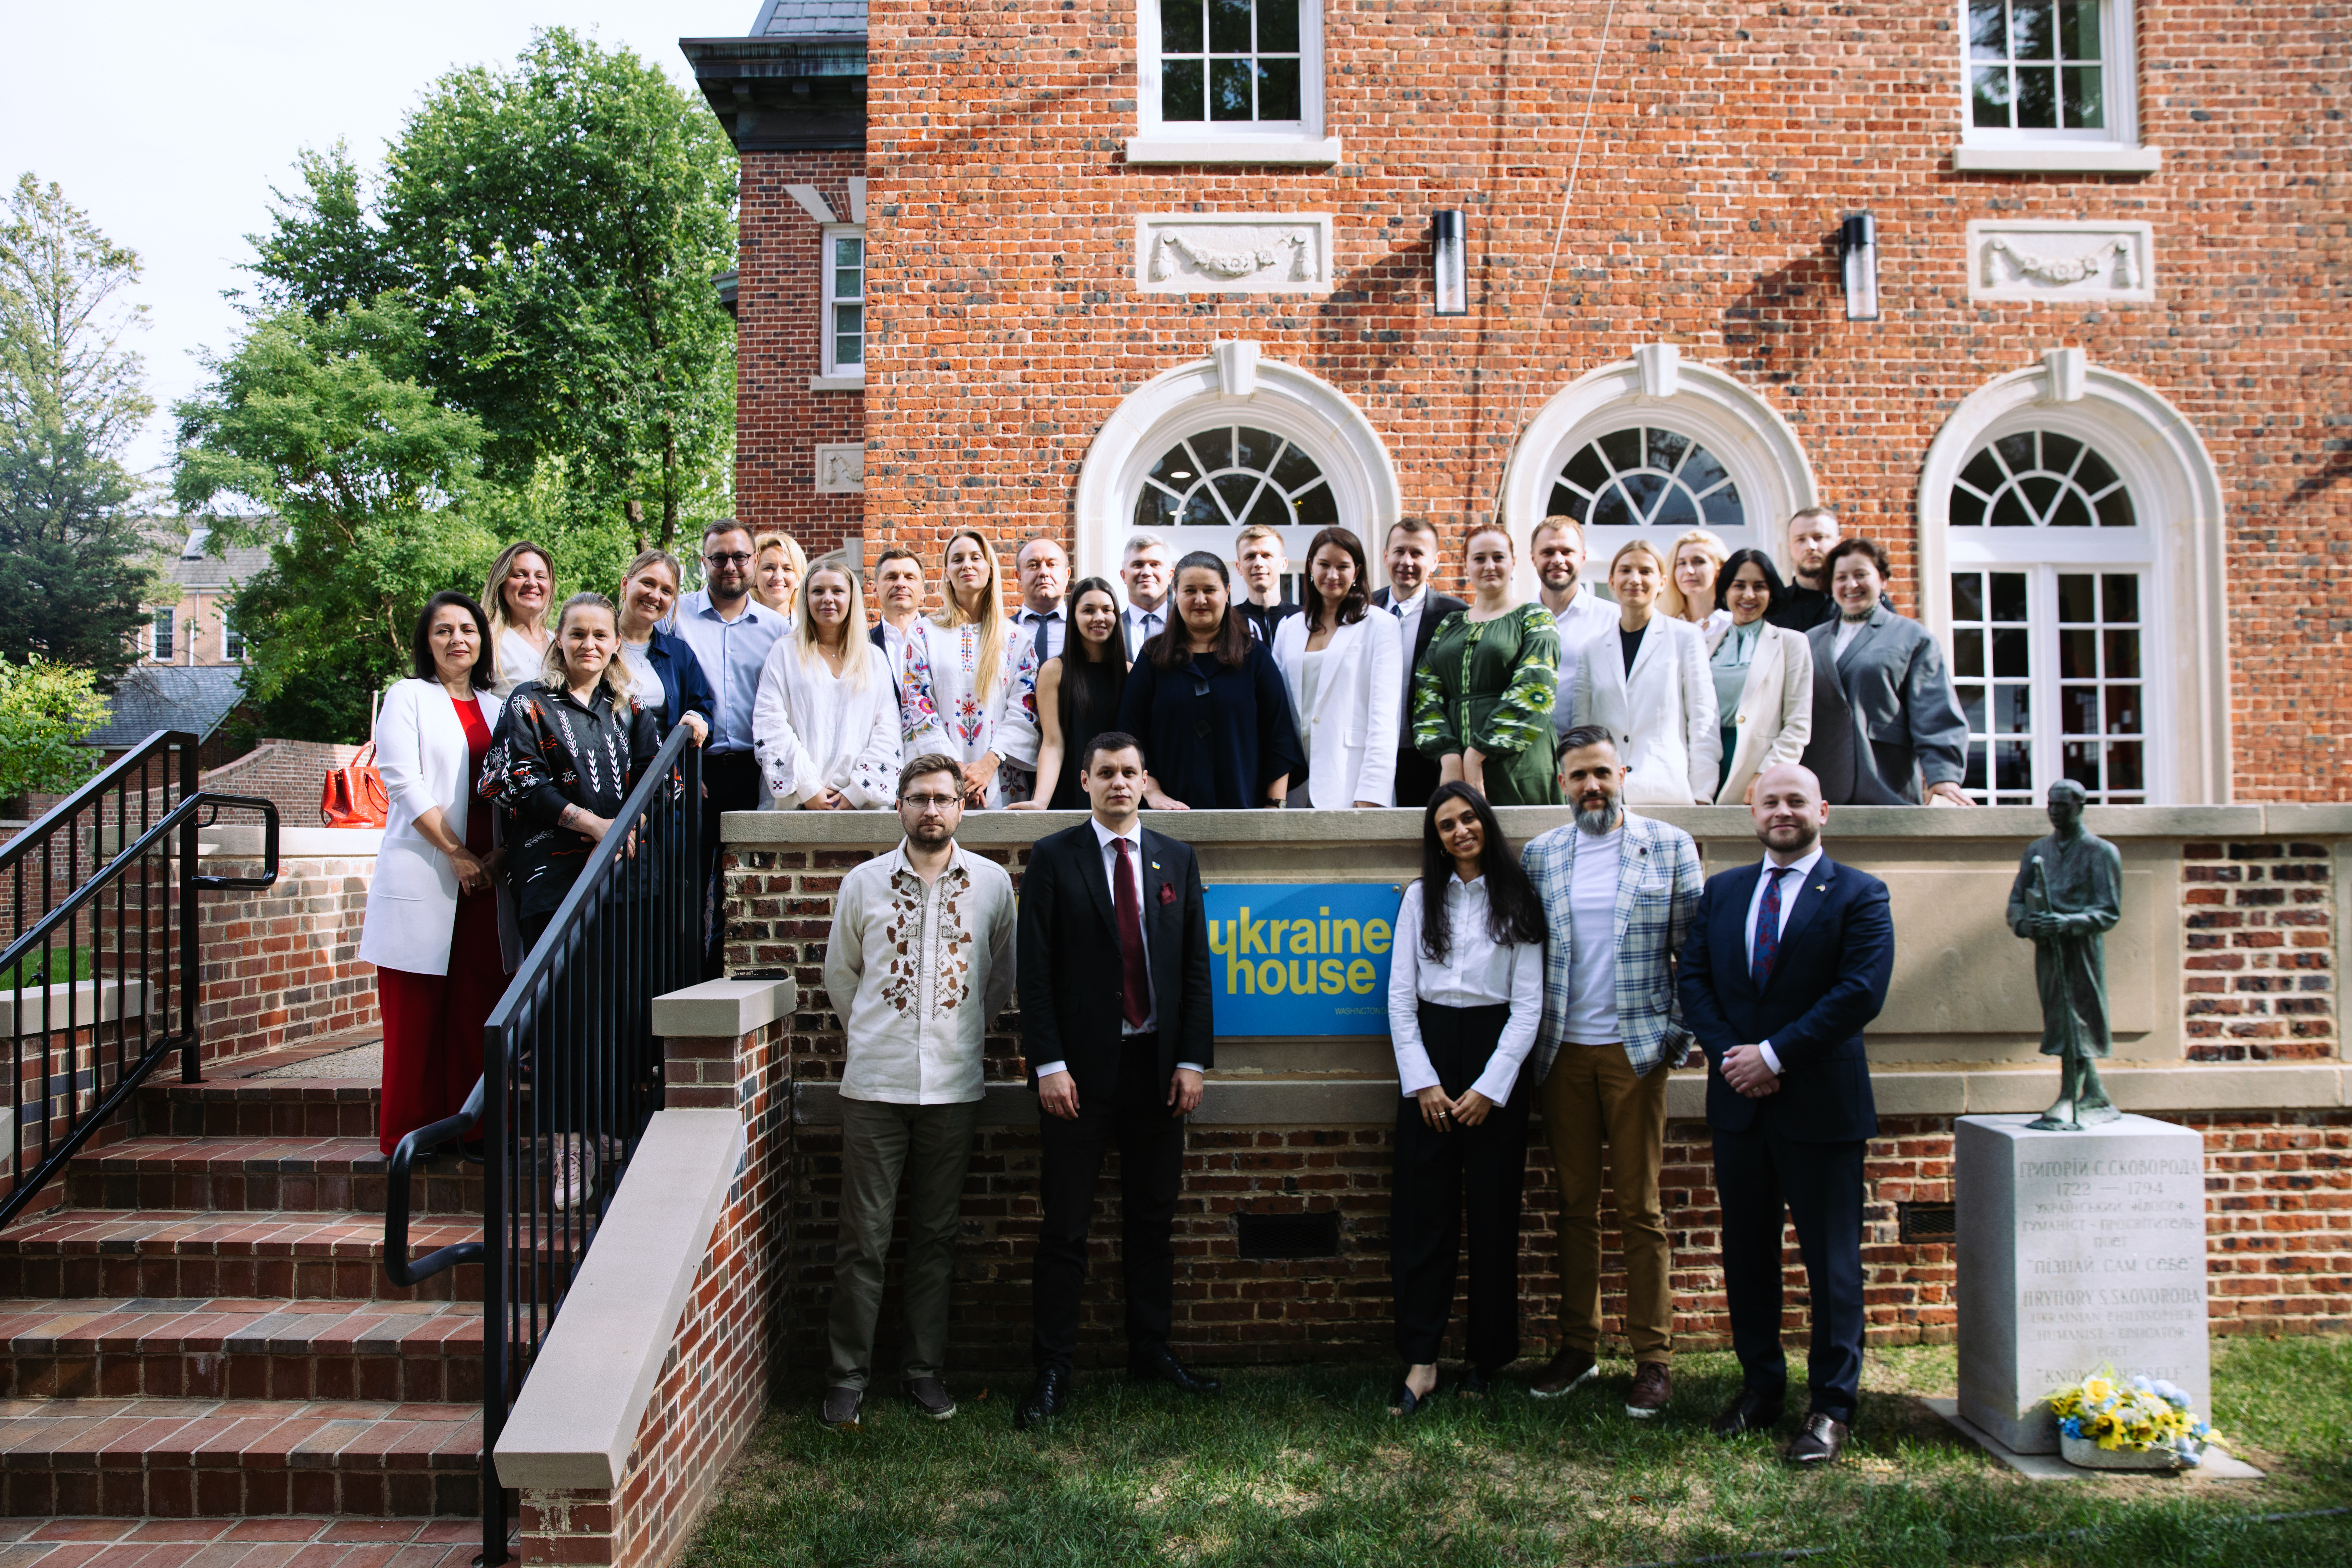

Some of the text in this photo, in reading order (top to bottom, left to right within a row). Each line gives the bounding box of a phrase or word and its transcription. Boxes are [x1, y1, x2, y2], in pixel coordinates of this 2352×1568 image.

[1209, 906, 1392, 955] ukraine
[1227, 958, 1376, 995] house
[2020, 1157, 2089, 1178] ГРИГОРІЙ
[2108, 1159, 2199, 1176] СКОВОРОДА
[2056, 1182, 2092, 1197] 1722
[2127, 1181, 2164, 1195] 1794
[2035, 1199, 2122, 1214] УКРАЇНСЬКИЙ
[2103, 1258, 2137, 1273] САМ
[2023, 1290, 2093, 1307] HRYHORY
[2111, 1287, 2201, 1304] SKOVORODA
[2031, 1311, 2101, 1324] UKRAINIAN
[2037, 1328, 2103, 1341] HUMANIST
[2097, 1346, 2129, 1357] POET
